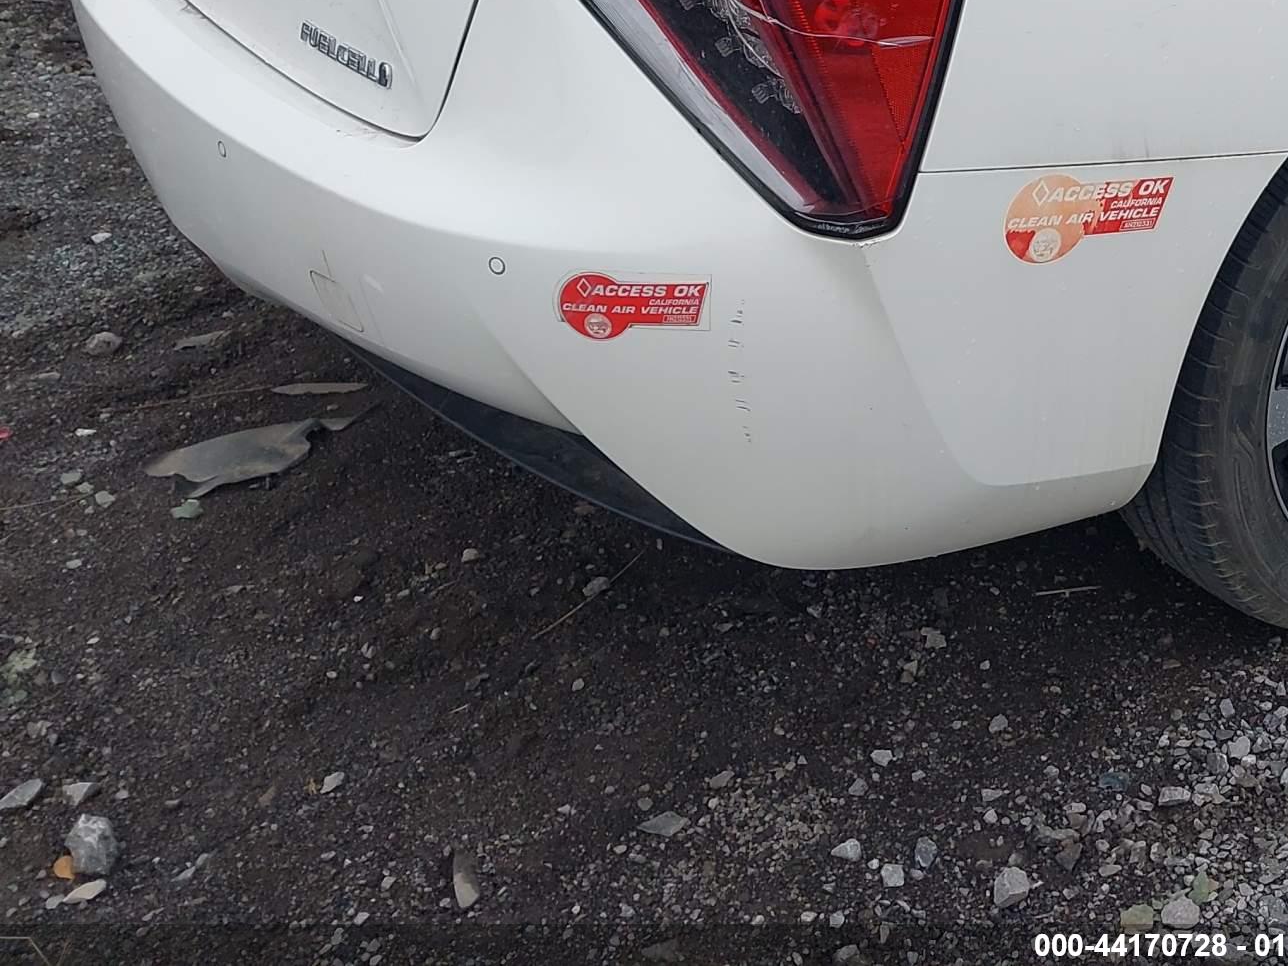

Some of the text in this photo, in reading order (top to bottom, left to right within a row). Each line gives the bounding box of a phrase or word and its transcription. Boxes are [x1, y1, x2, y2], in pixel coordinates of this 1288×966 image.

[1048, 179, 1169, 203] ACCESS OK
[1110, 197, 1162, 209] CALIFORNIA
[1007, 207, 1160, 229] CLEAN AIR VEHICLE
[591, 285, 704, 297] ACCESS OK
[648, 298, 699, 306] CALIFORNIA
[562, 303, 699, 314] CLEAN AIR VEHICLE
